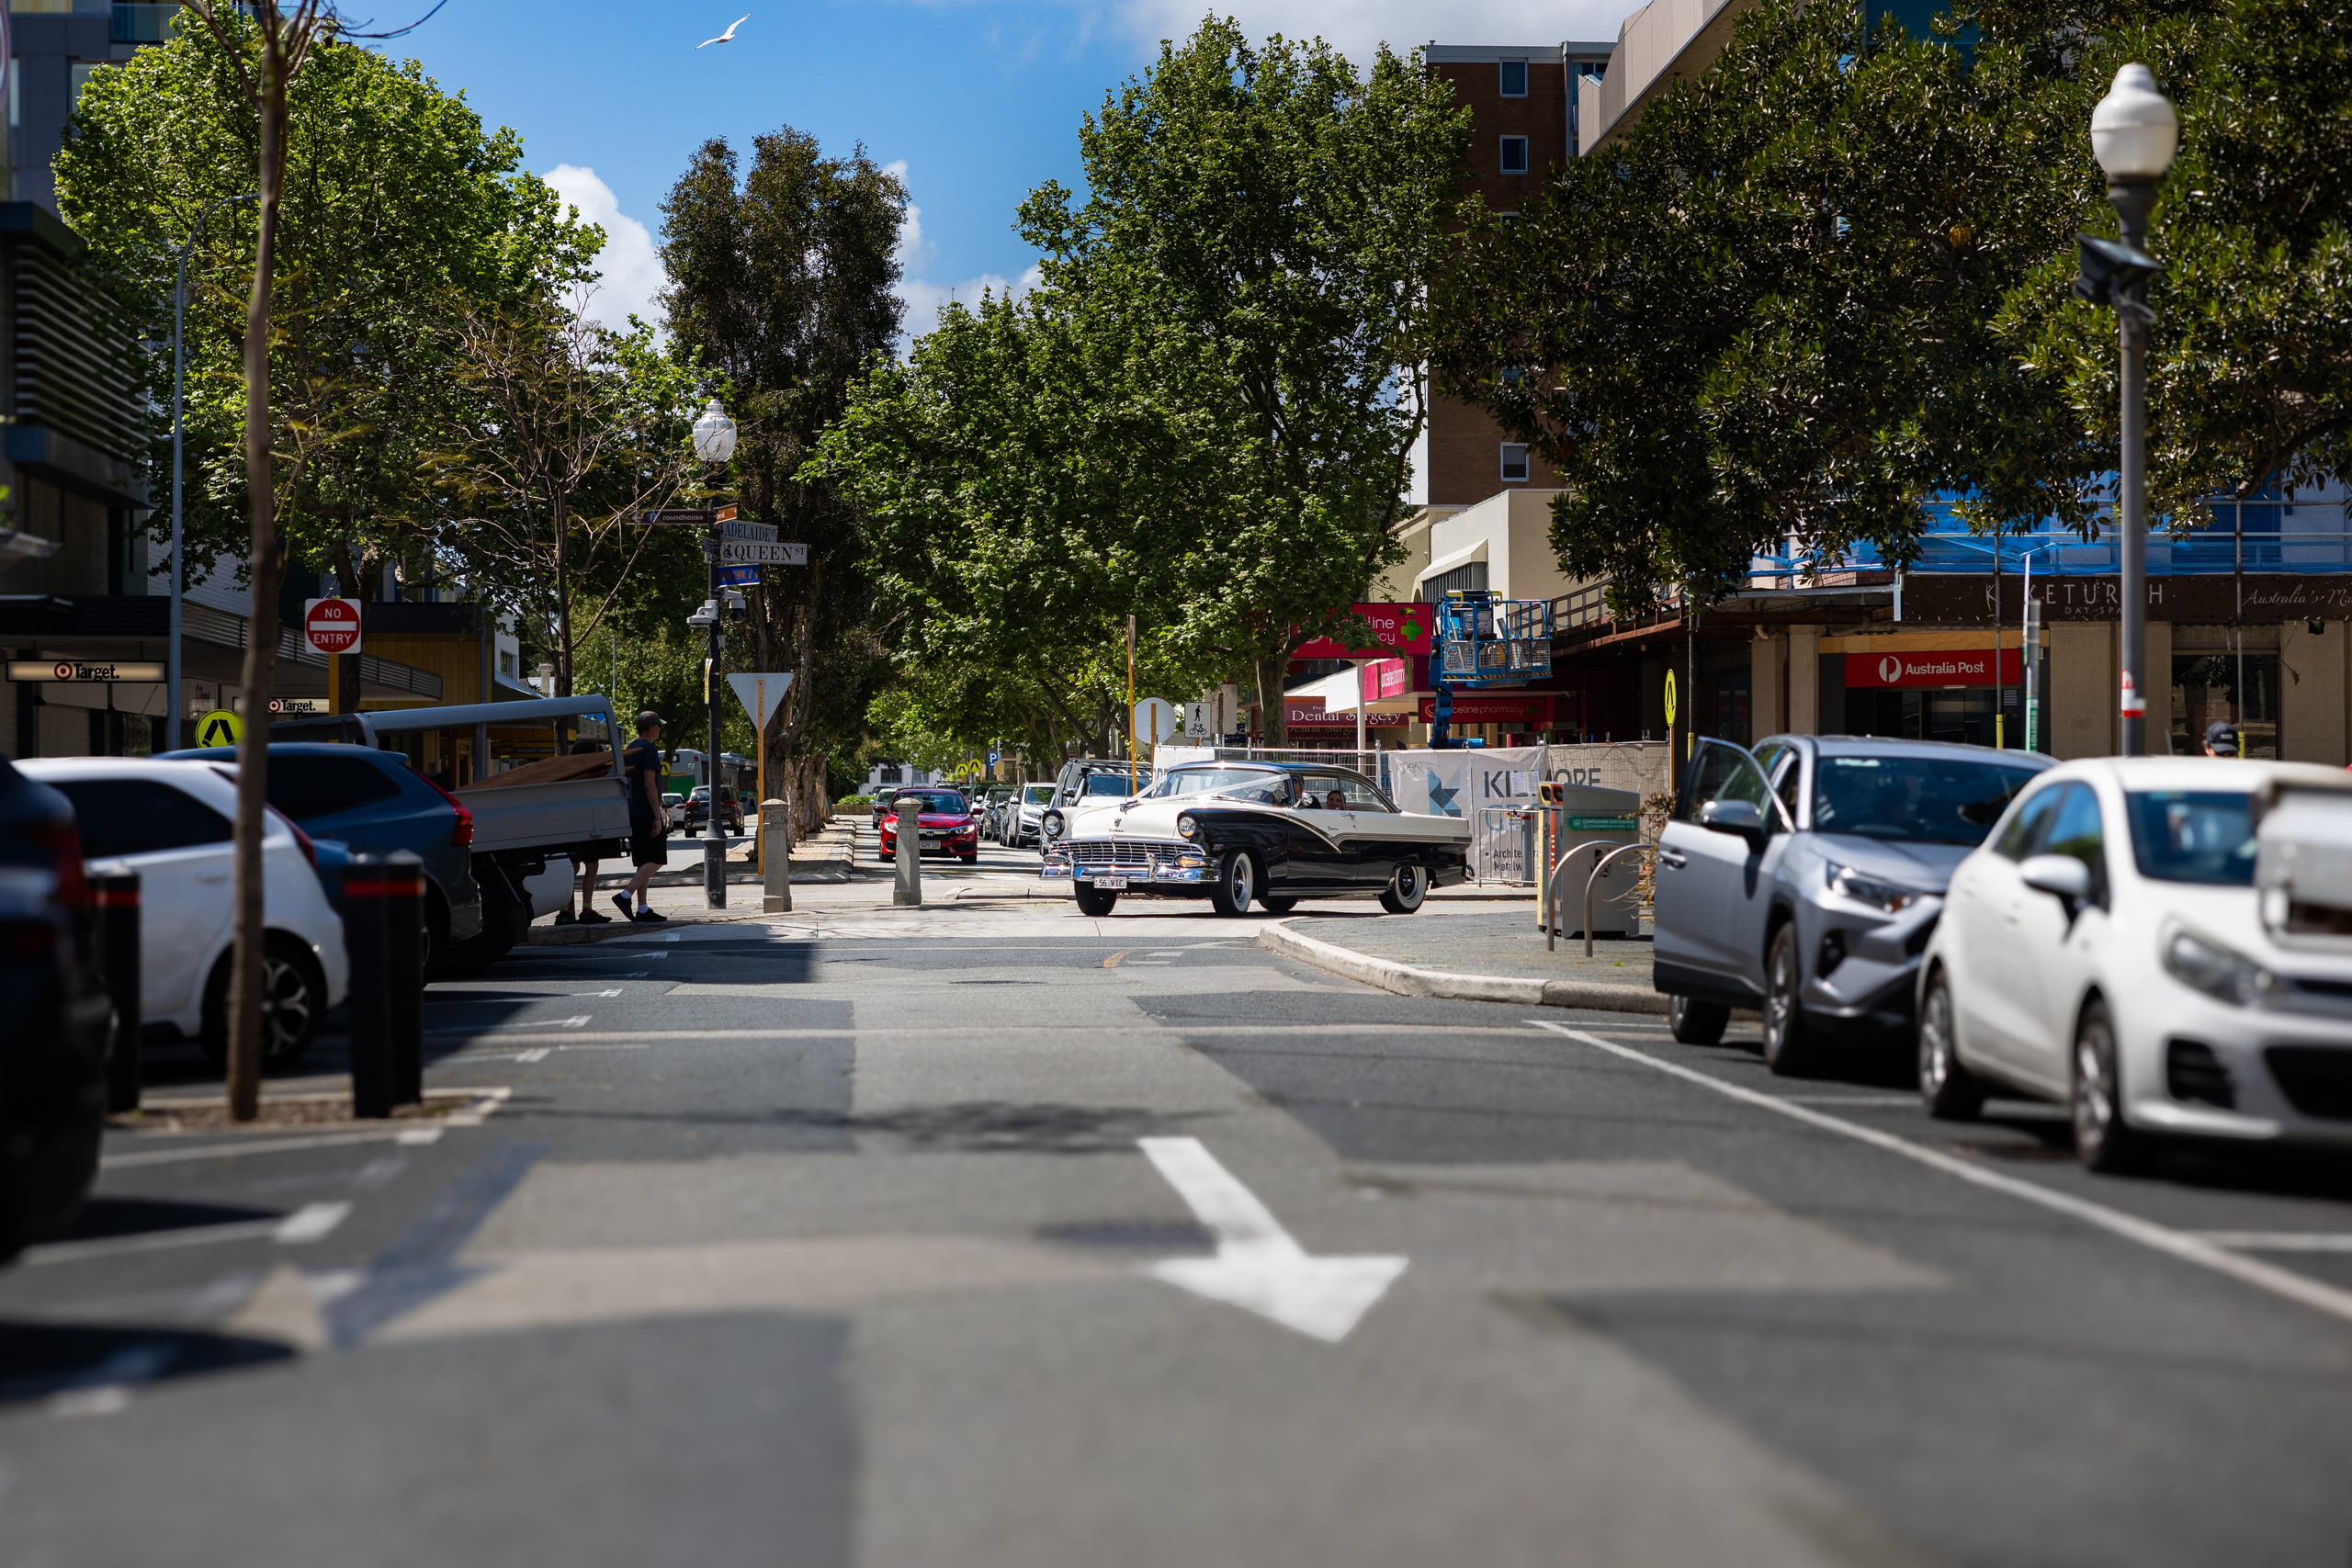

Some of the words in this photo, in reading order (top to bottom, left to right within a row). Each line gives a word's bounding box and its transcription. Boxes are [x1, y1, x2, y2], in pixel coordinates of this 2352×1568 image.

[725, 525, 770, 542] ADELAIDE
[770, 528, 777, 536] ST
[735, 545, 793, 561] QUEEN
[794, 547, 806, 556] ST
[324, 608, 342, 619] NO
[2064, 606, 2090, 615] DAY
[313, 633, 353, 644] ENTRY
[1905, 661, 1957, 675] Australia
[1958, 660, 1984, 673] Post
[1479, 705, 1523, 715] pharmacy
[1291, 709, 1340, 722] Dental
[1345, 712, 1401, 725] Srgery
[989, 753, 998, 763] P
[1110, 879, 1125, 887] VIC
